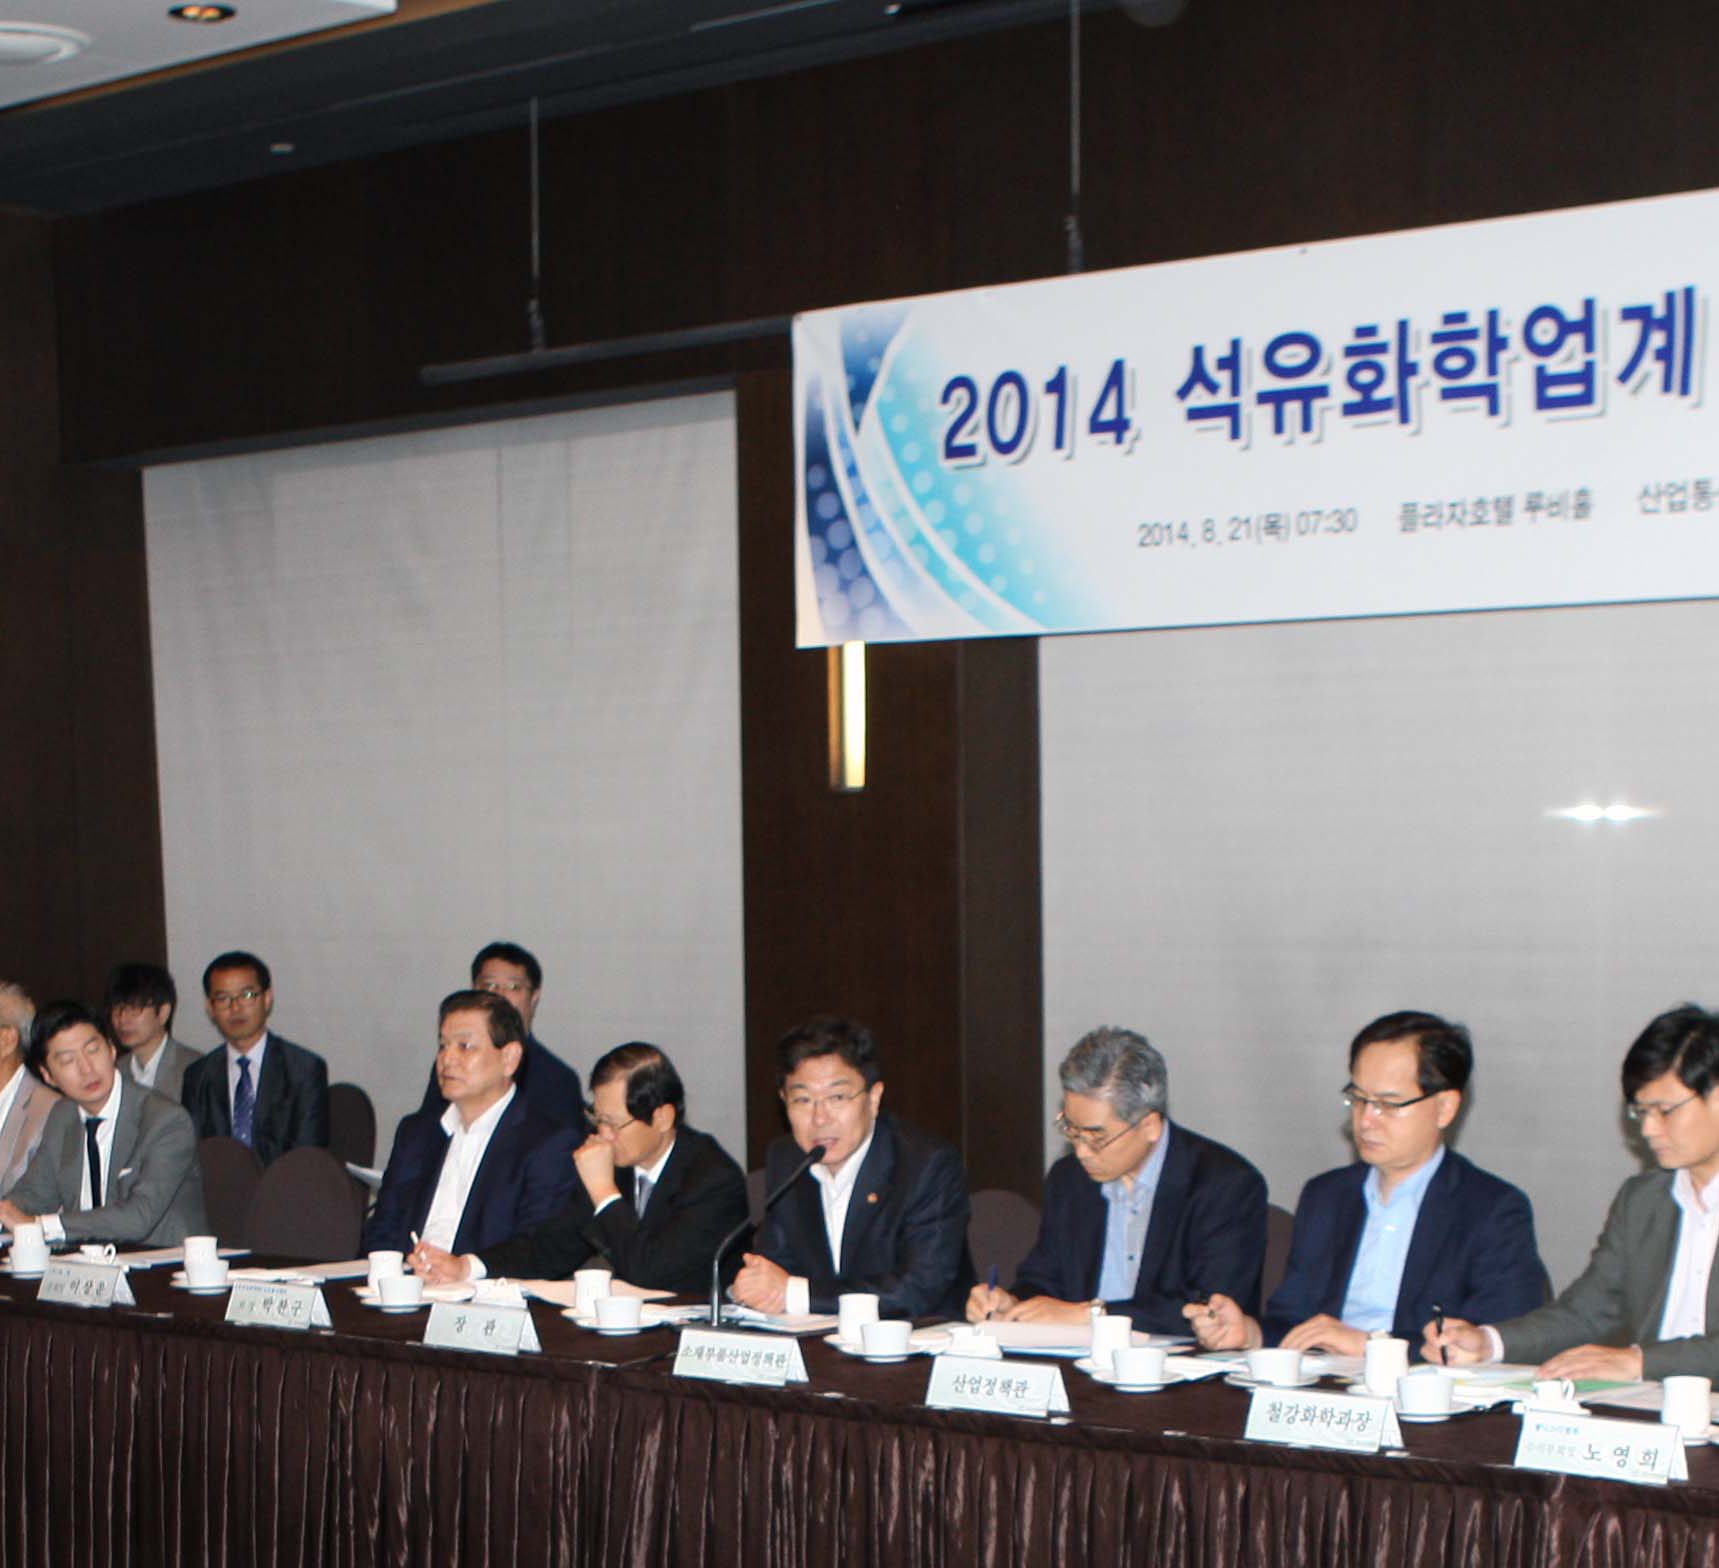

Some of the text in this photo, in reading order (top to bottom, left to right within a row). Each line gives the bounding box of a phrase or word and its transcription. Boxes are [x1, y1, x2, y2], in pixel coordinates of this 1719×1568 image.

[940, 359, 1132, 460] 2014
[1173, 285, 1698, 440] 석유화학업계
[1295, 507, 1359, 538] 07:30
